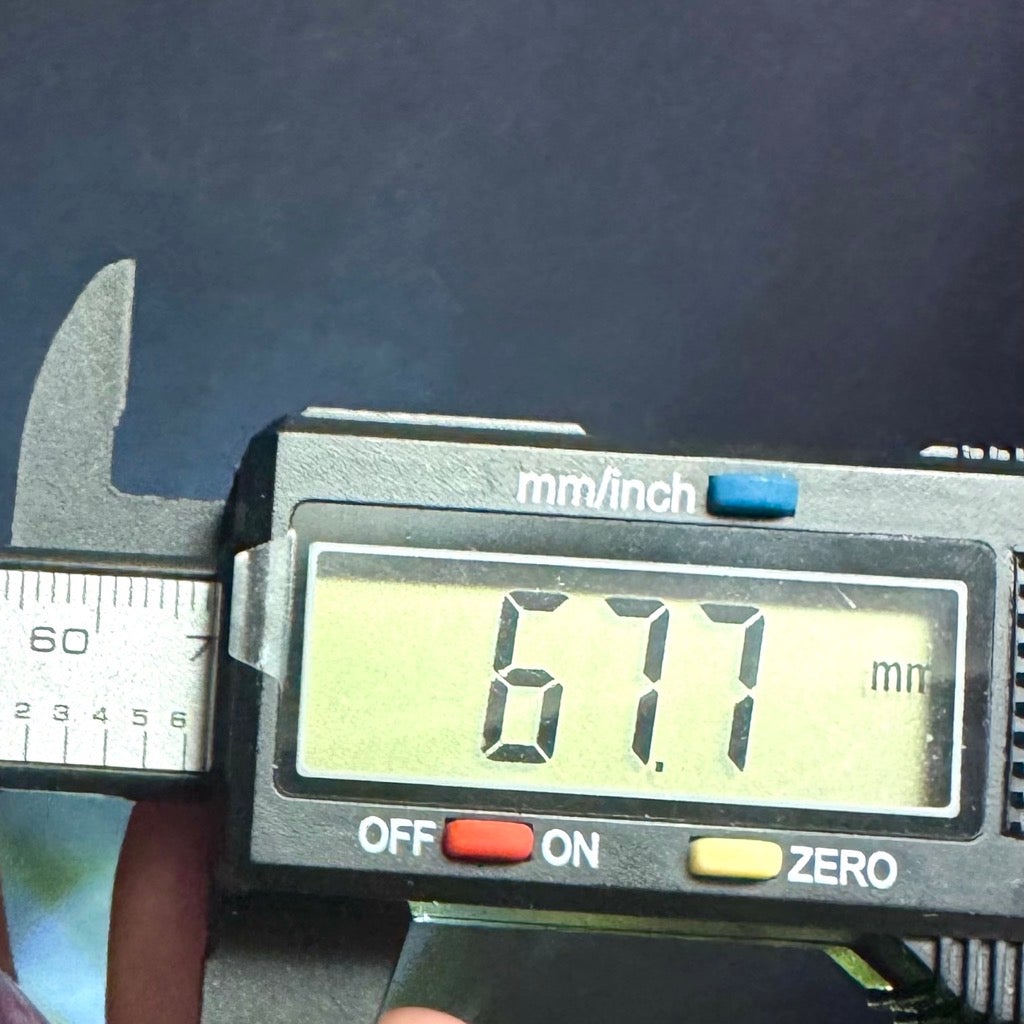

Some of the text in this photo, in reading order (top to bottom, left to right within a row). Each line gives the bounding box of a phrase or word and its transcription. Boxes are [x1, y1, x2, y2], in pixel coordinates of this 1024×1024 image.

[516, 467, 697, 514] mm/inch
[30, 626, 89, 655] 60
[482, 590, 764, 773] 67.7
[14, 702, 30, 719] 2
[53, 704, 69, 721] 3
[93, 707, 108, 722] 4
[132, 709, 148, 726] 5
[170, 712, 186, 729] 6
[358, 816, 437, 856] OFF
[541, 830, 600, 869] ON
[787, 845, 898, 890] ZERO
